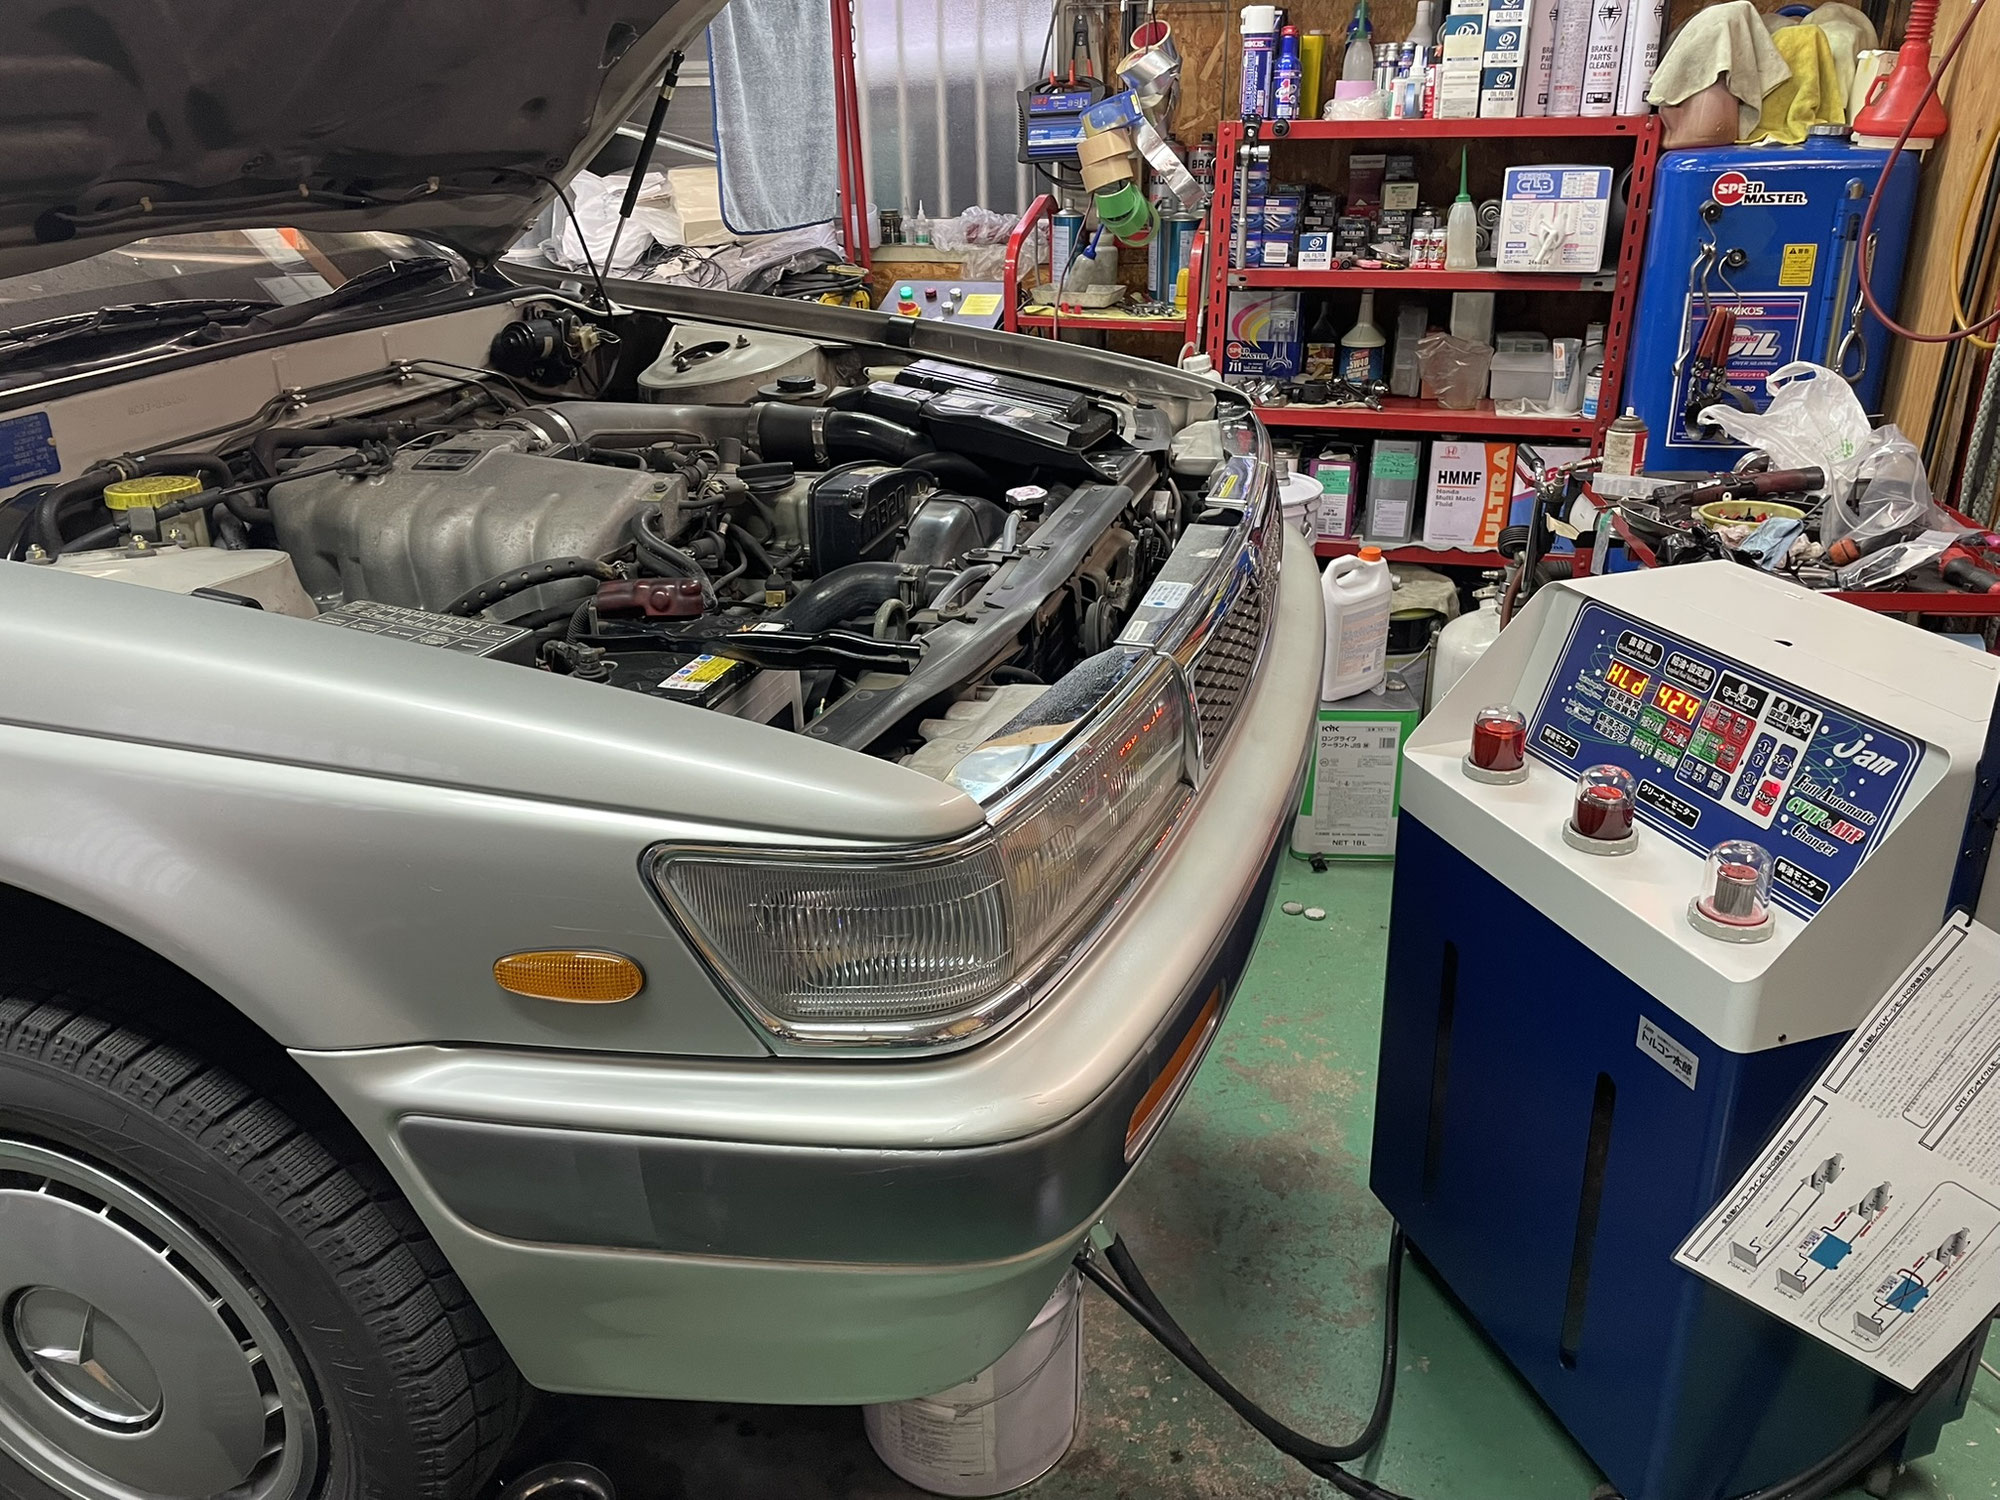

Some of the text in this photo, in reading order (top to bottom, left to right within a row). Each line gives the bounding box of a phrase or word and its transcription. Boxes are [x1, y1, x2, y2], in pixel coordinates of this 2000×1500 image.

[1505, 11, 1522, 19] FILTER
[1590, 53, 1611, 61] PARTS
[1591, 45, 1613, 53] BRAKE
[1717, 183, 1764, 195] SPEED
[1743, 193, 1805, 204] MASTER
[1228, 362, 1242, 372] 711
[1437, 470, 1482, 486] HMMF
[1483, 446, 1511, 545] ULTRA
[1657, 684, 1699, 719] 424
[1720, 685, 1759, 709] モード選択
[1772, 754, 1793, 769] スタート
[1640, 782, 1697, 821] クリーナーモニター
[1756, 791, 1777, 806] ストップ
[1794, 774, 1877, 825] Full Automatic
[1790, 822, 1838, 857] Changer
[1776, 861, 1825, 894] 廃油モニター
[1641, 1030, 1693, 1076] トルコン太郎
